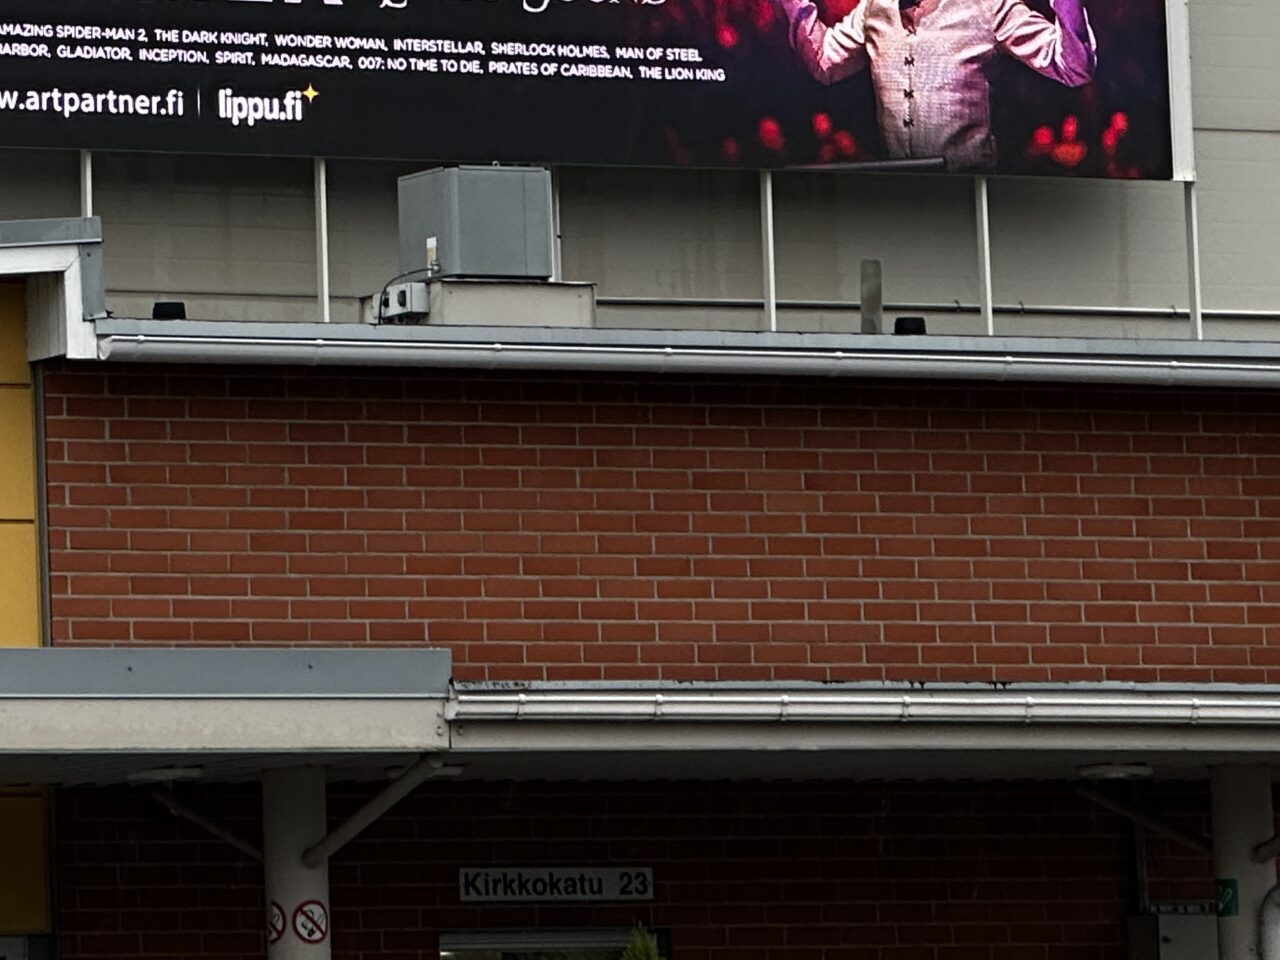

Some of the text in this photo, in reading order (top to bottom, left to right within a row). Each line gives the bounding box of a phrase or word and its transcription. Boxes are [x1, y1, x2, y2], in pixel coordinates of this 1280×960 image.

[55, 25, 135, 41] SPIDER-MAN
[136, 28, 149, 43] 2,
[154, 28, 180, 43] THE
[182, 30, 218, 45] DARK
[220, 32, 269, 47] KNIGHT,
[274, 33, 333, 49] WONDER
[491, 42, 556, 57] SHERLOCK
[557, 44, 611, 60] HOLMES,
[615, 46, 645, 60] MAN
[646, 47, 664, 60] OF
[665, 47, 704, 63] STEEL
[138, 48, 210, 64] INCEPTION,
[357, 56, 386, 71] 007:
[386, 57, 408, 71] NO
[408, 57, 439, 72] TIME
[440, 58, 459, 73] TO
[459, 59, 484, 75] DIE,
[488, 61, 540, 76] PIRATES
[540, 63, 558, 76] OF
[638, 65, 664, 79] THE
[664, 67, 695, 81] LION
[696, 68, 726, 83] KING
[218, 87, 303, 126] lippu.fi
[464, 872, 649, 896] Kirkkokatu 23
